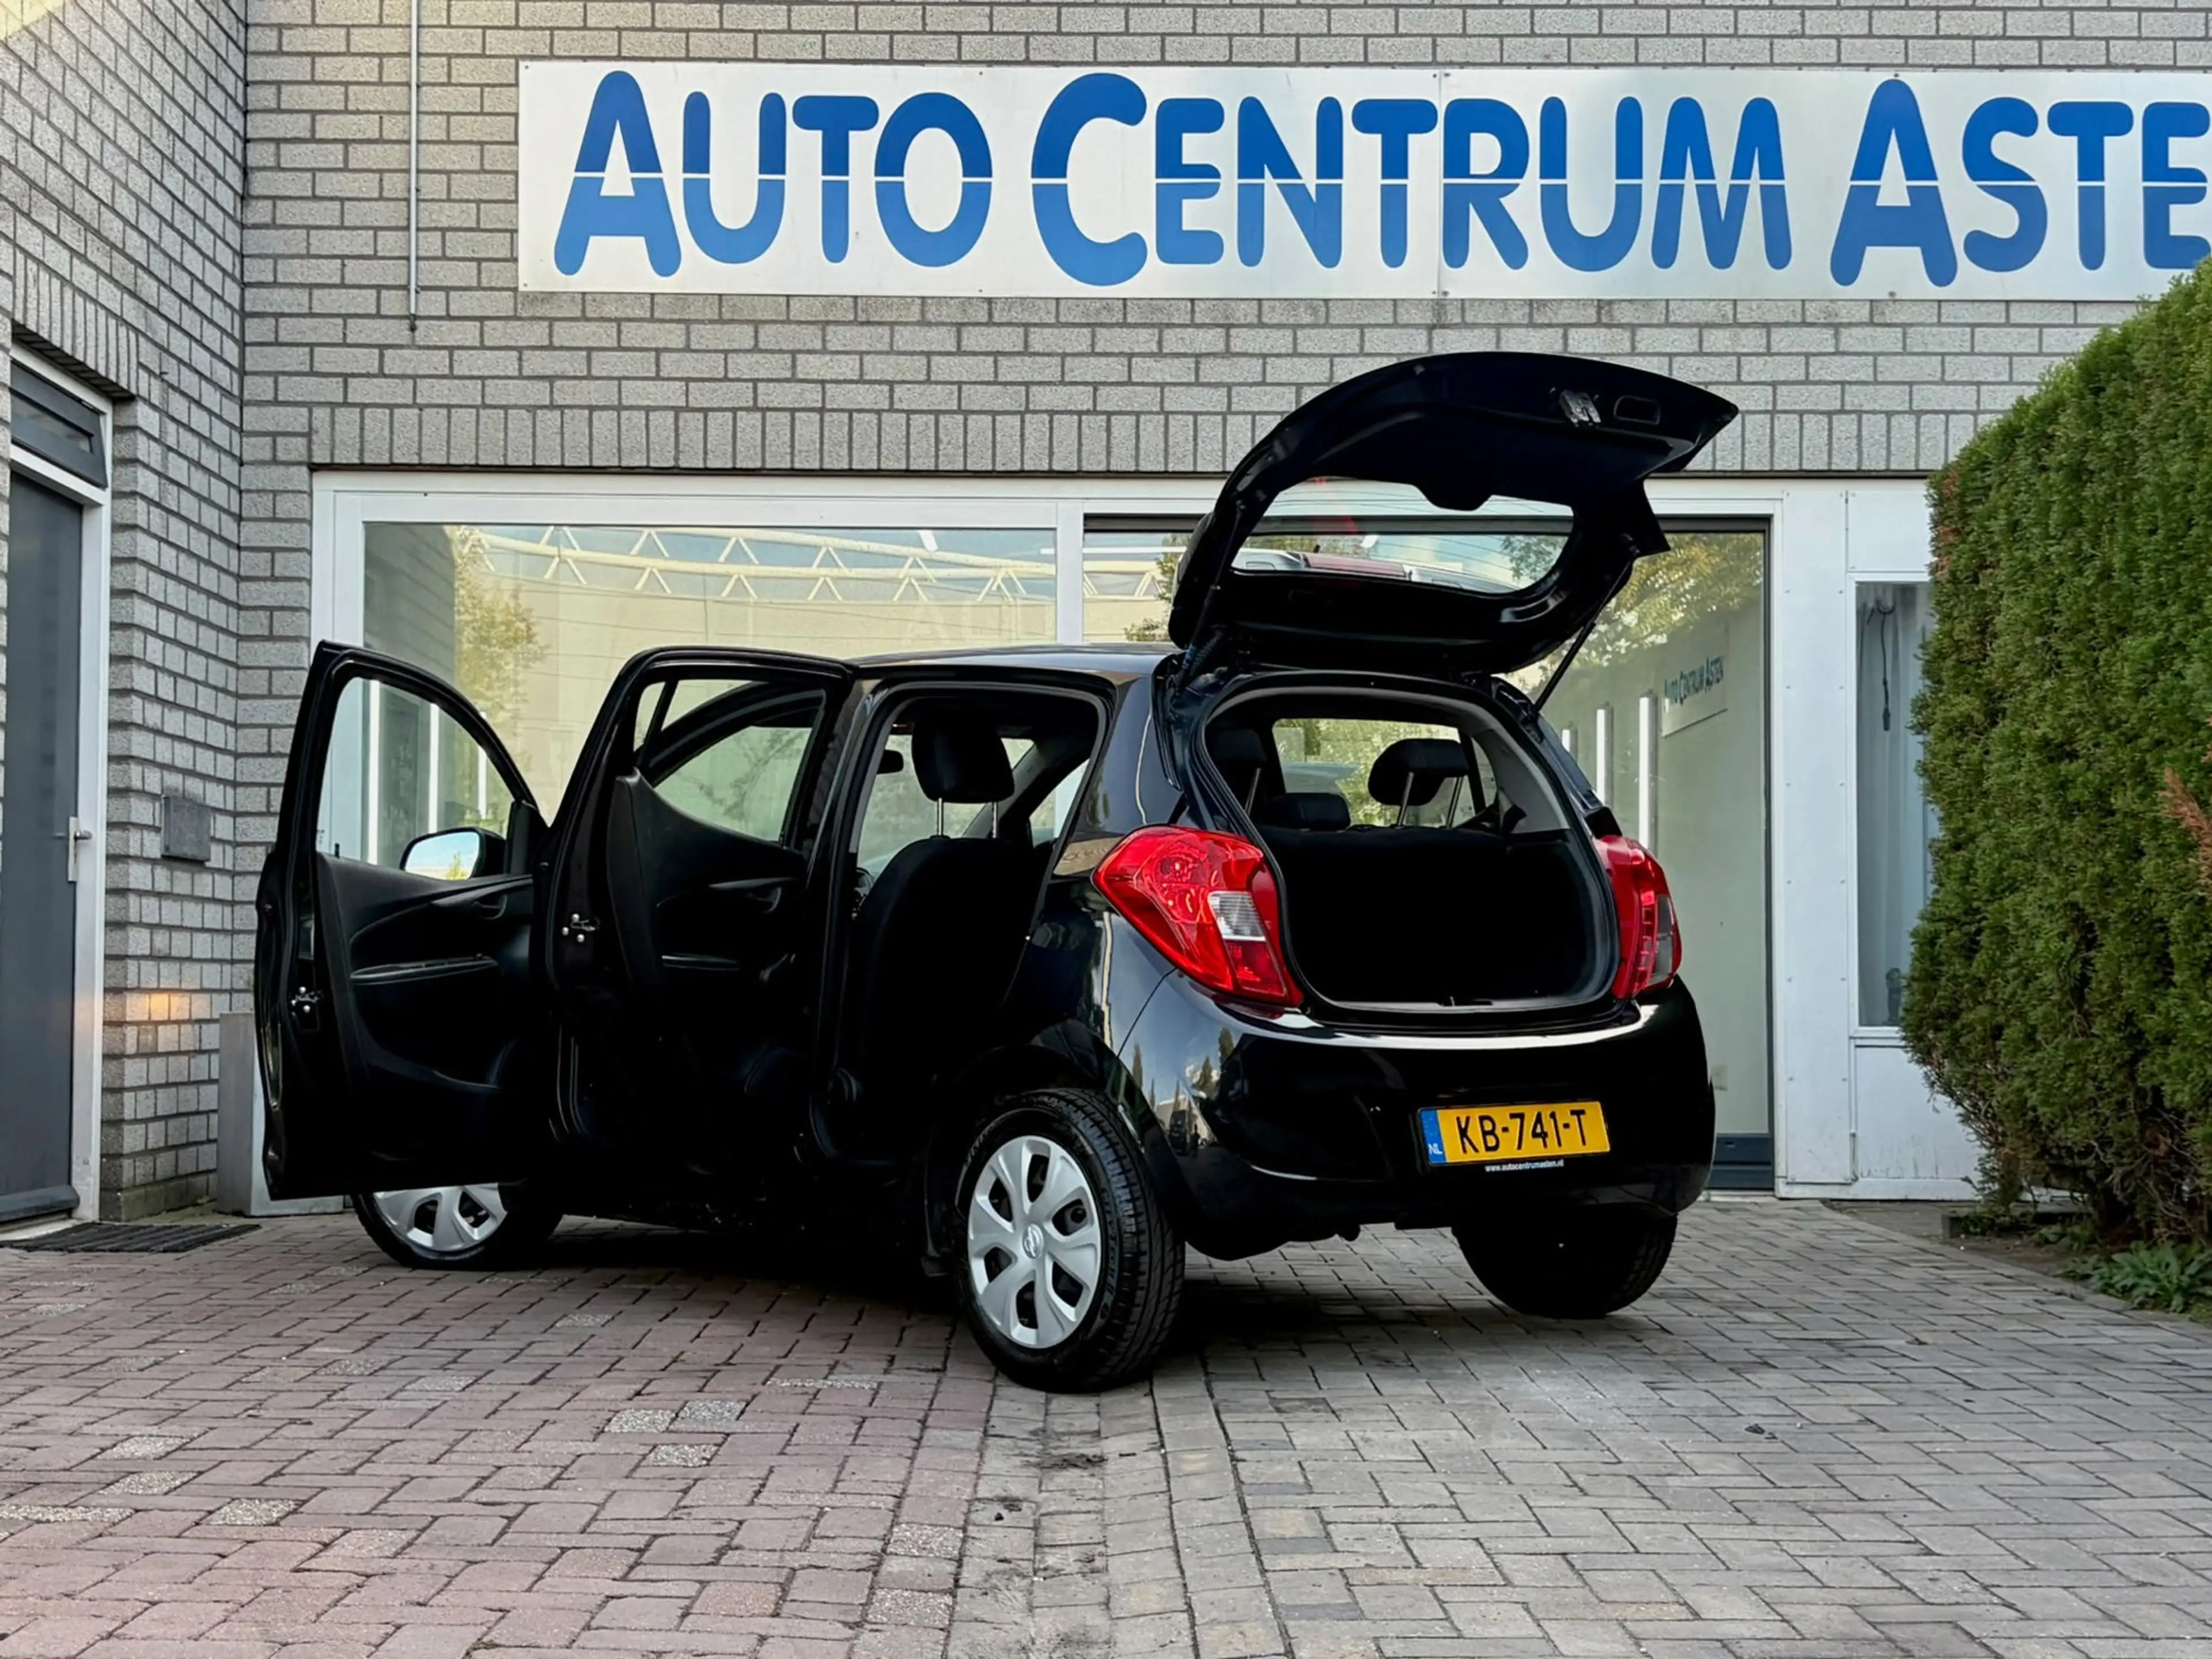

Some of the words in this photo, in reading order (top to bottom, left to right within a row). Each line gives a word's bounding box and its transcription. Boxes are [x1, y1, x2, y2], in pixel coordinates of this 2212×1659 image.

[554, 71, 994, 278] AUTO
[1032, 73, 1792, 287] CENTRUM
[1428, 1143, 1443, 1156] NL
[1456, 1109, 1586, 1154] KB-741-T
